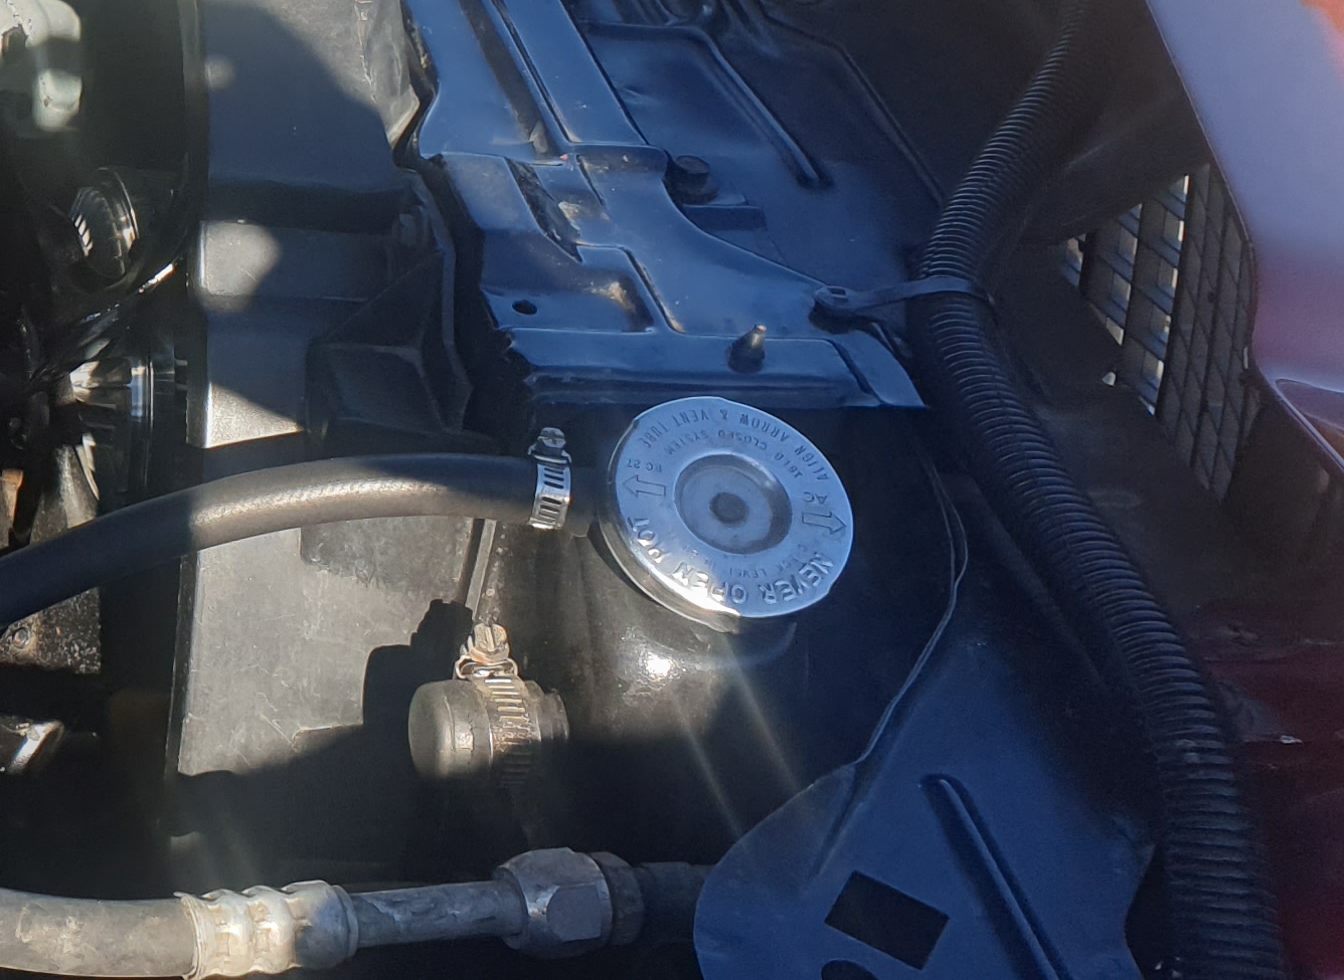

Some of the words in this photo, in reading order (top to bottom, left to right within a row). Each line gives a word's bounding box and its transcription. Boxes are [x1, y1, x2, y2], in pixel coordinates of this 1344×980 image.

[674, 409, 709, 426] VENT
[739, 413, 789, 442] ARROW
[803, 491, 827, 504] AC
[627, 516, 665, 564] HOT
[673, 561, 748, 604] OPEN
[760, 551, 833, 604] NEVER
